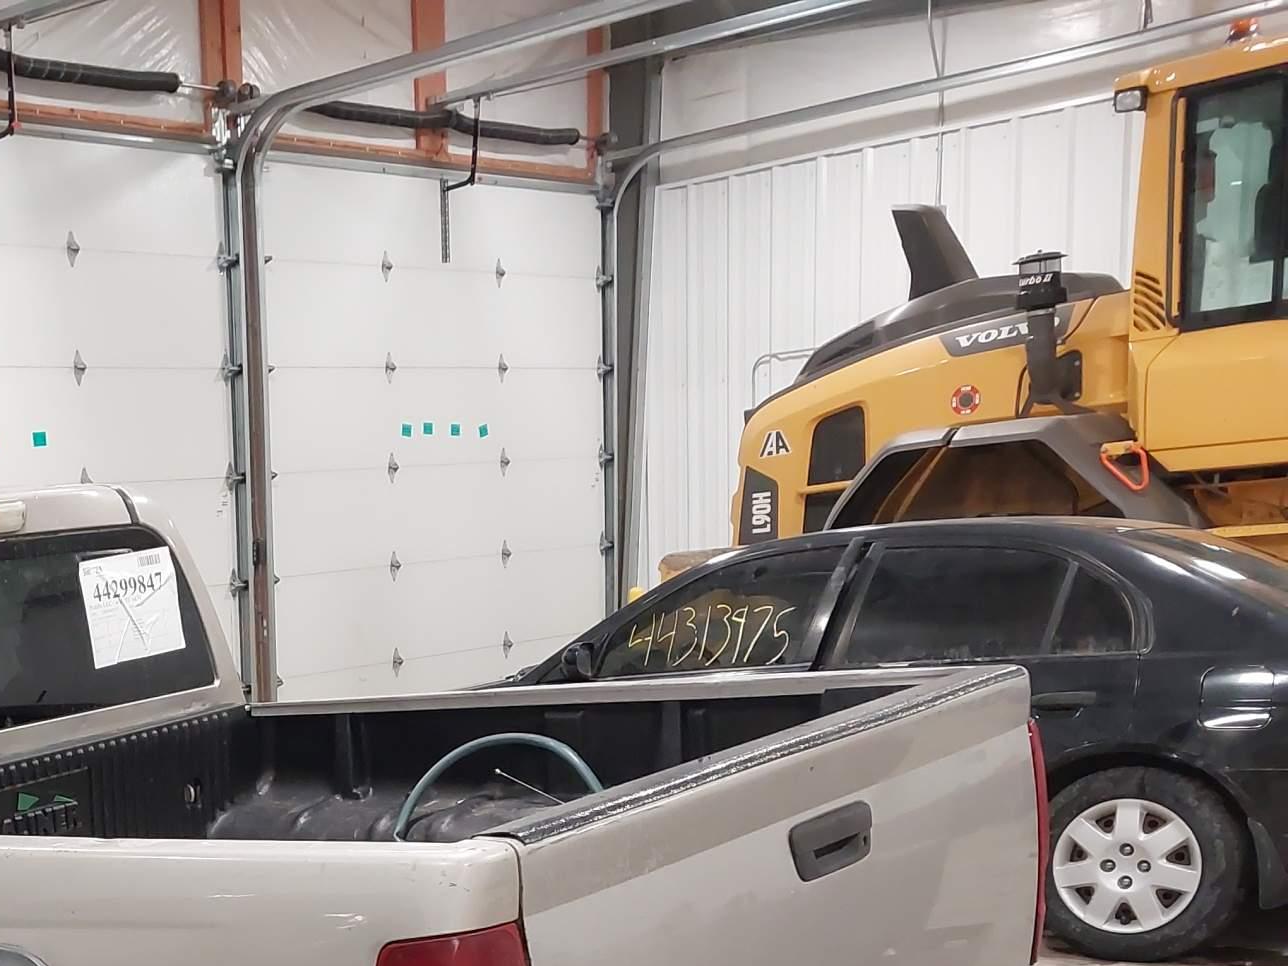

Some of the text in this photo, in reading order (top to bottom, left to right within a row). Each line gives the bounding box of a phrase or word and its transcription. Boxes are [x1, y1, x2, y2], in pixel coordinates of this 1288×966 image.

[955, 316, 1060, 348] VOLV
[751, 491, 772, 535] L90H
[93, 571, 162, 602] 44299847
[628, 604, 797, 667] 44313975
